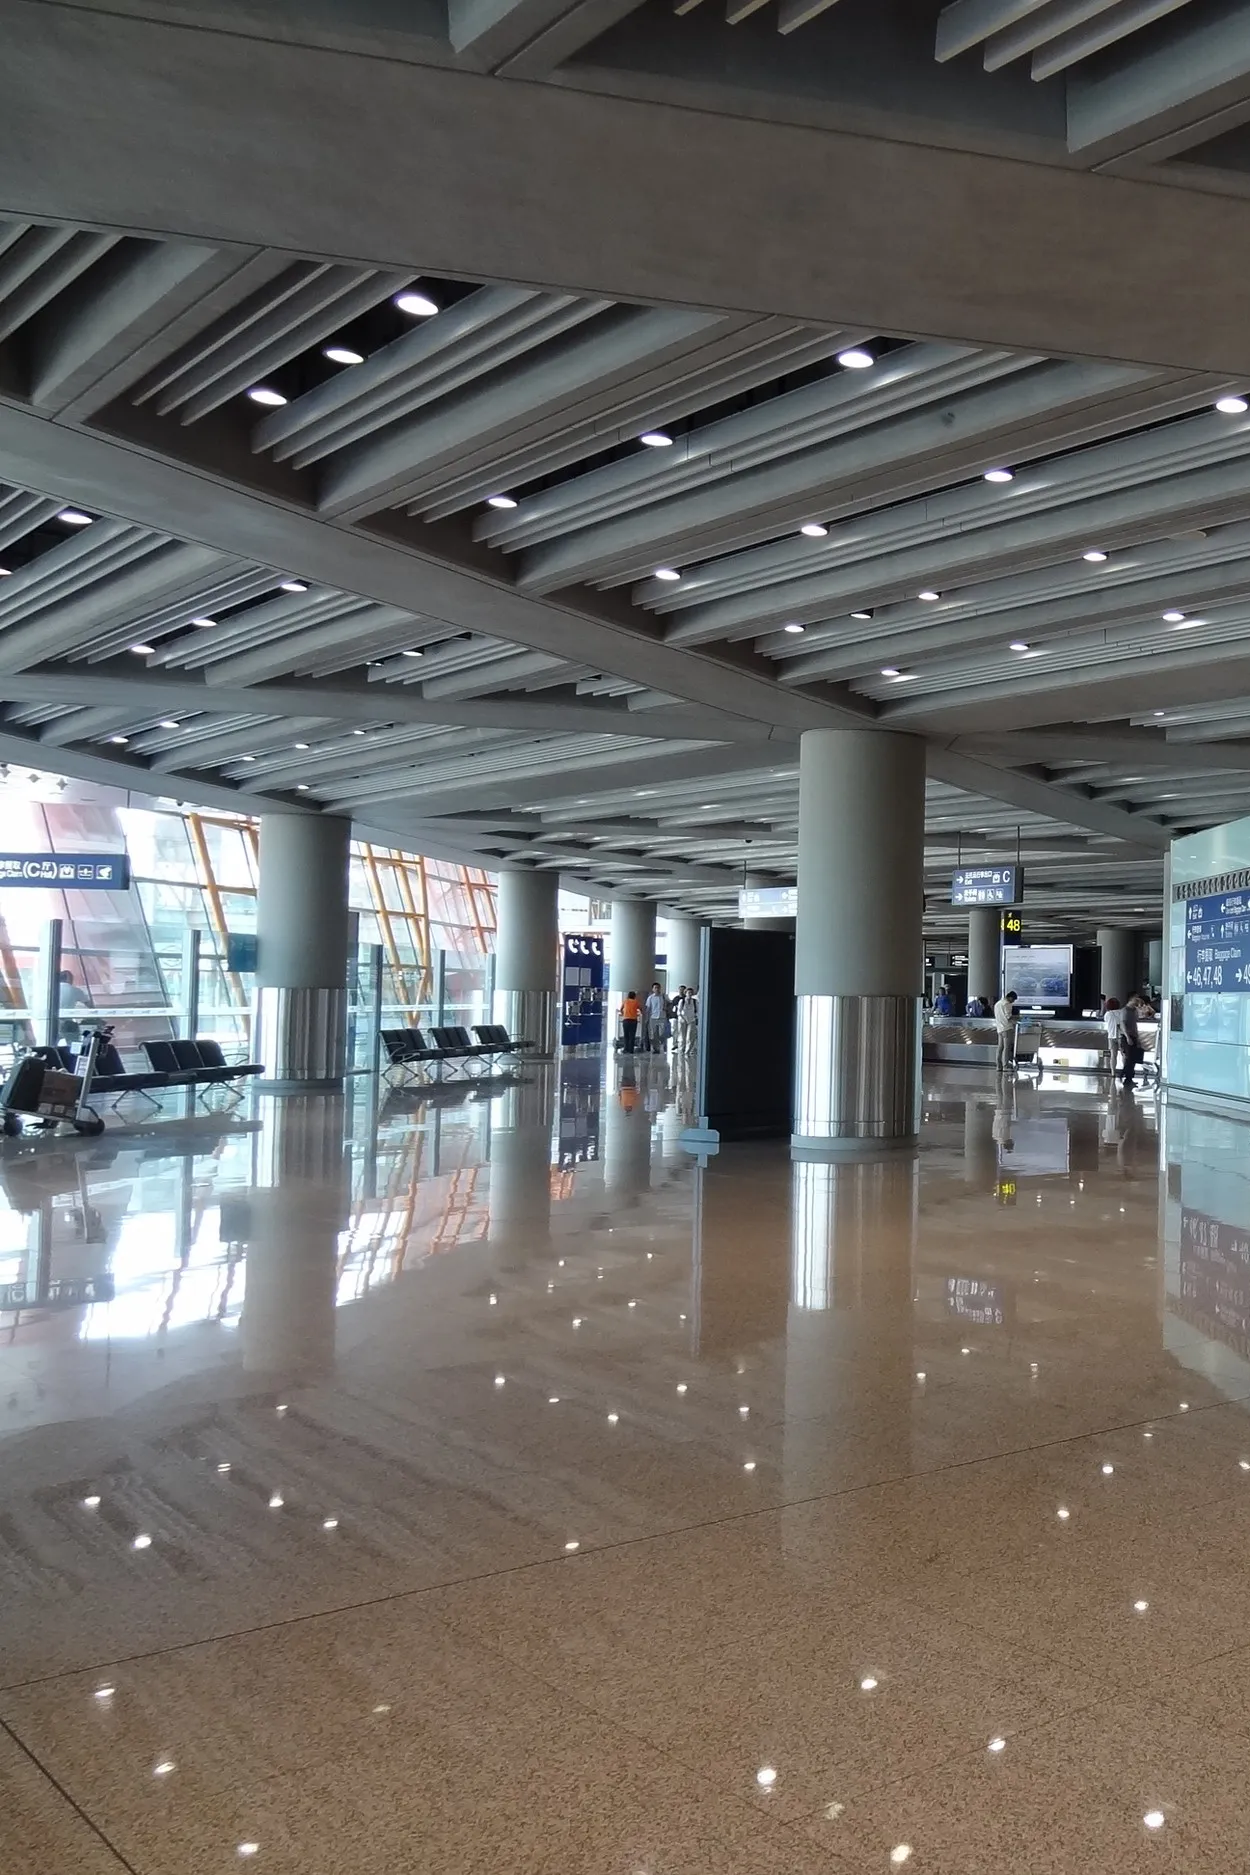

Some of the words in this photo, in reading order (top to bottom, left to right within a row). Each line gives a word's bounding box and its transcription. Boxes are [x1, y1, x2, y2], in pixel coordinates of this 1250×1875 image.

[1002, 870, 1011, 883] C
[1006, 919, 1021, 932] 48
[1215, 949, 1230, 961] Baggage
[1231, 947, 1241, 958] Claim
